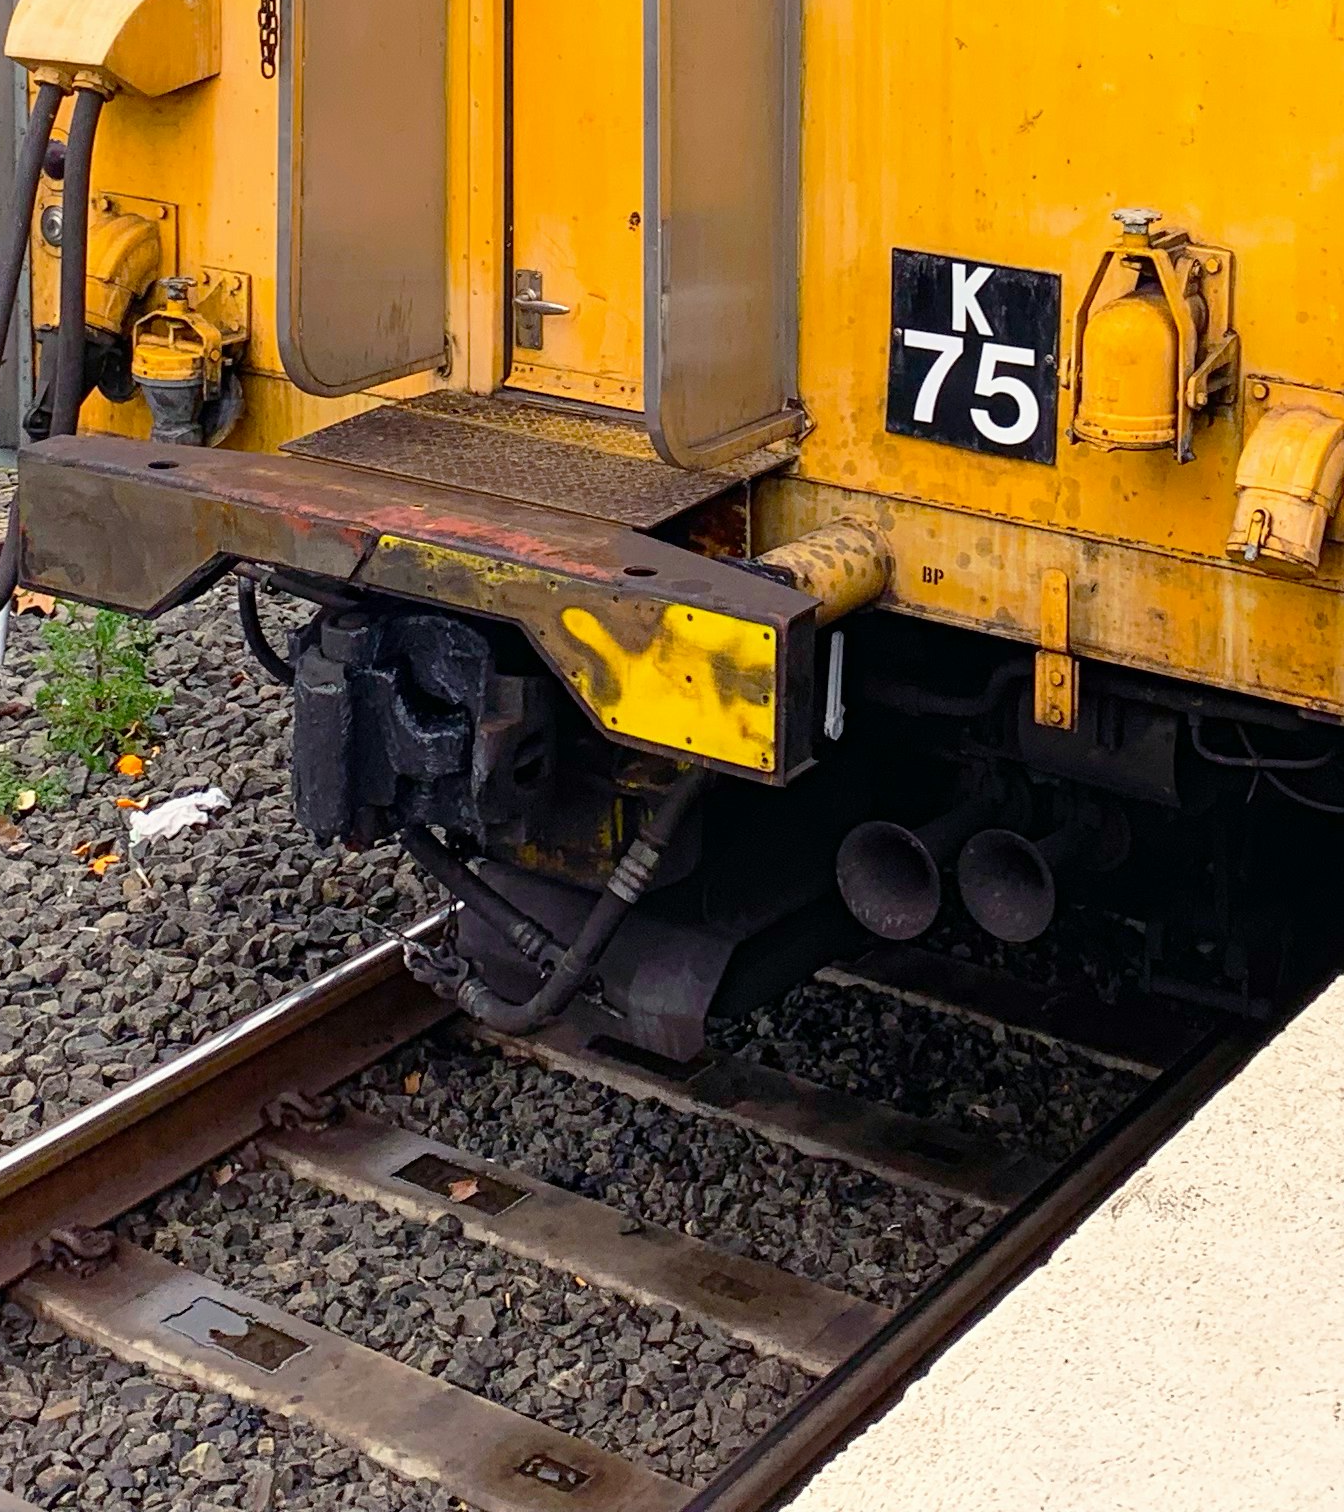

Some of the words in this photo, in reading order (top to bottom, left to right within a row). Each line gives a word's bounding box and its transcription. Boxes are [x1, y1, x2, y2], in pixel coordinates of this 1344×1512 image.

[951, 263, 996, 337] K
[903, 329, 1040, 446] 75
[922, 566, 944, 585] BP
